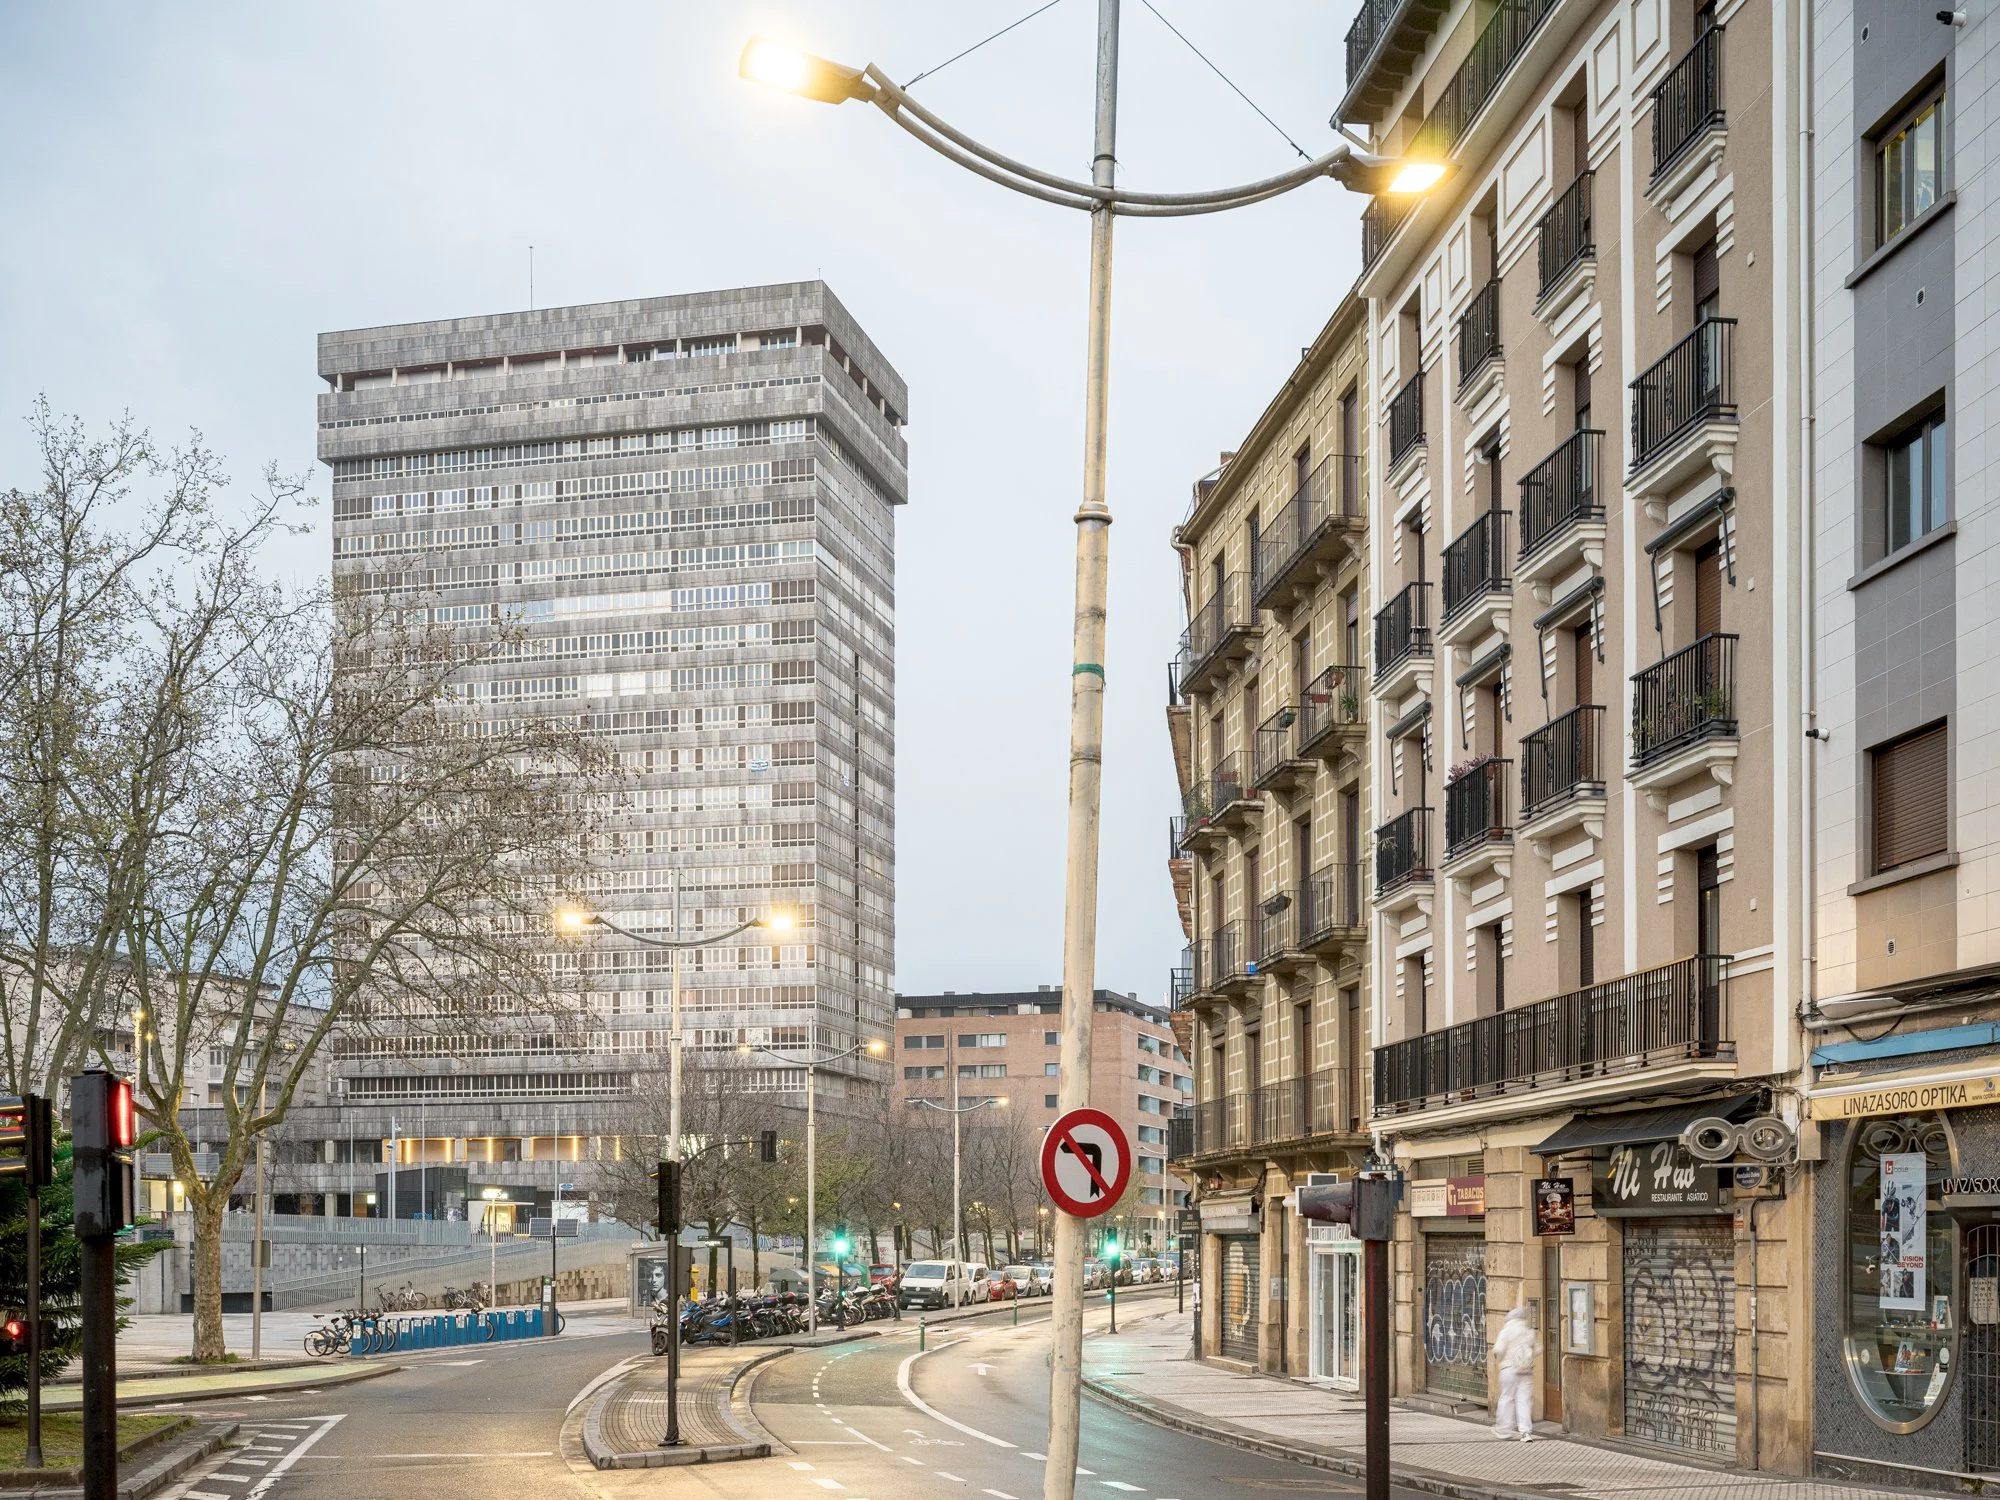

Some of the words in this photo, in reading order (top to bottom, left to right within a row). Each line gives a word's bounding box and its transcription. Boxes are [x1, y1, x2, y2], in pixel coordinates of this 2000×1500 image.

[1843, 1090, 1917, 1116] LINAZASORO
[1920, 1084, 1967, 1110] OPTIKA
[1609, 1144, 1641, 1200] Ni
[1457, 1186, 1484, 1200] TABACOS
[1651, 1193, 1683, 1203] RESTAURANTE
